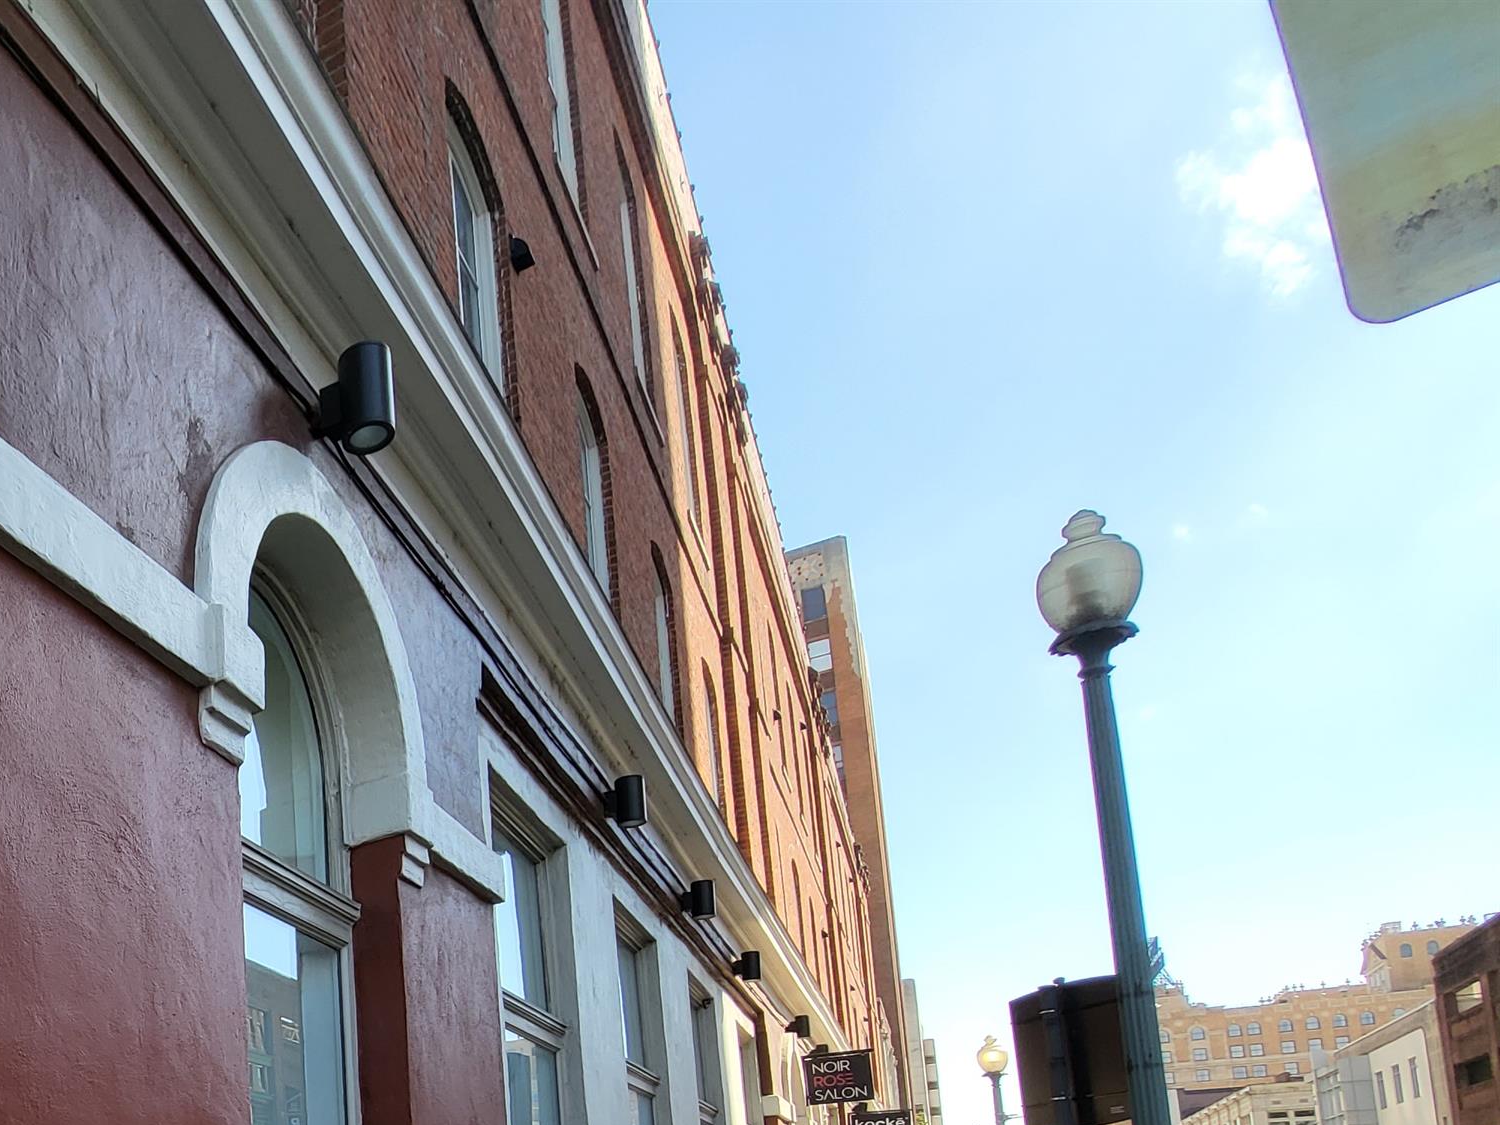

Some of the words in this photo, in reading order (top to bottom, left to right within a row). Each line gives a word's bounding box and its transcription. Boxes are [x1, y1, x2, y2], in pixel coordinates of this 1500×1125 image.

[812, 1060, 851, 1074] NOIR
[813, 1073, 854, 1088] ROSE
[815, 1086, 868, 1101] SALON
